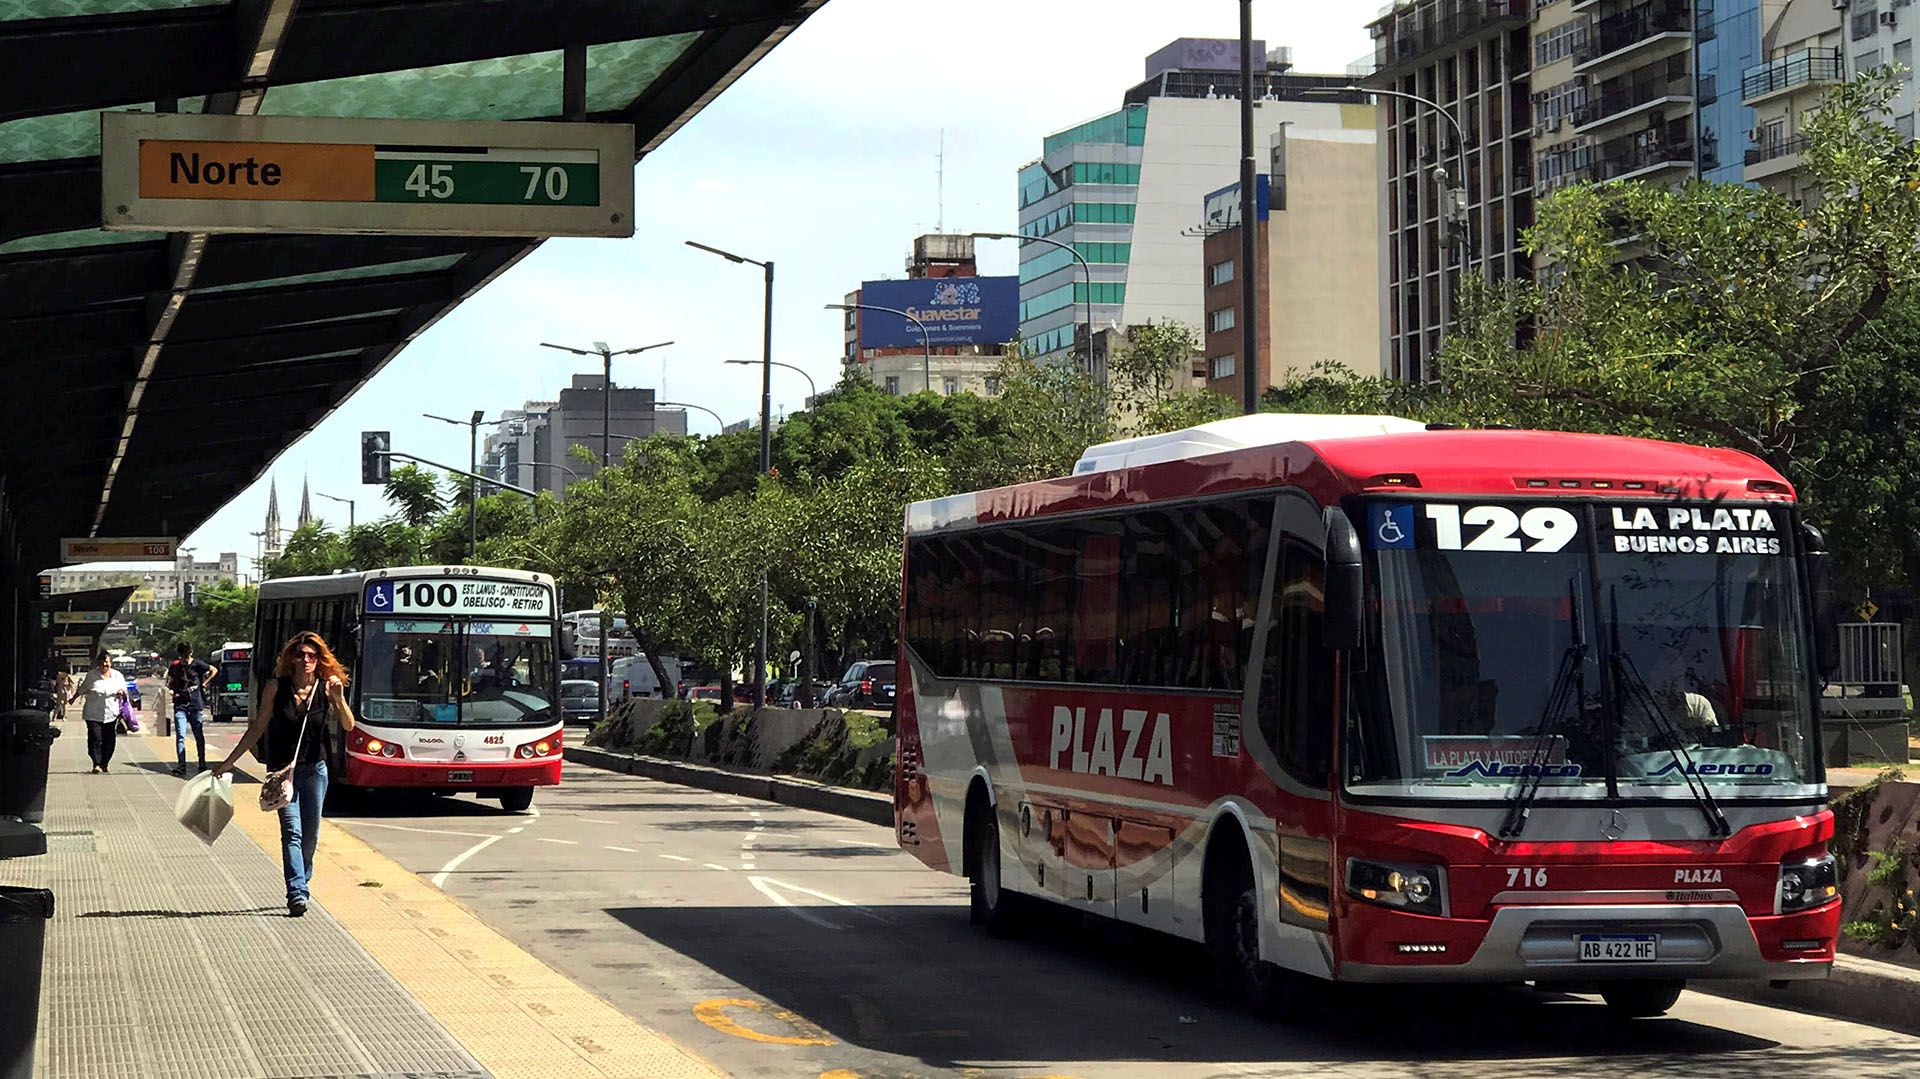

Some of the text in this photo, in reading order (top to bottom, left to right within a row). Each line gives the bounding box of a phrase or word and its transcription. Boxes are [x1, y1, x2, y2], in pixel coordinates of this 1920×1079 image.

[170, 152, 569, 200] Norte 45 70
[906, 307, 981, 321] Suavestar
[1612, 507, 1776, 532] LA PLATA
[1425, 504, 1578, 553] 129
[148, 546, 165, 555] 100
[1614, 535, 1780, 554] BUENOS AIRES
[396, 583, 457, 607] 100
[462, 584, 475, 595] EST.
[463, 596, 506, 608] OBELISCO
[512, 599, 543, 610] RETIRO
[1049, 705, 1174, 787] PLAZA
[1433, 751, 1447, 766] LA
[1450, 751, 1482, 766] PLATA
[1484, 751, 1492, 764] X
[1646, 760, 1773, 777] Alenco
[1506, 868, 1722, 887] 716 PLAZA
[1675, 891, 1712, 901] Italbus
[1584, 943, 1652, 958] AB 422 HF
